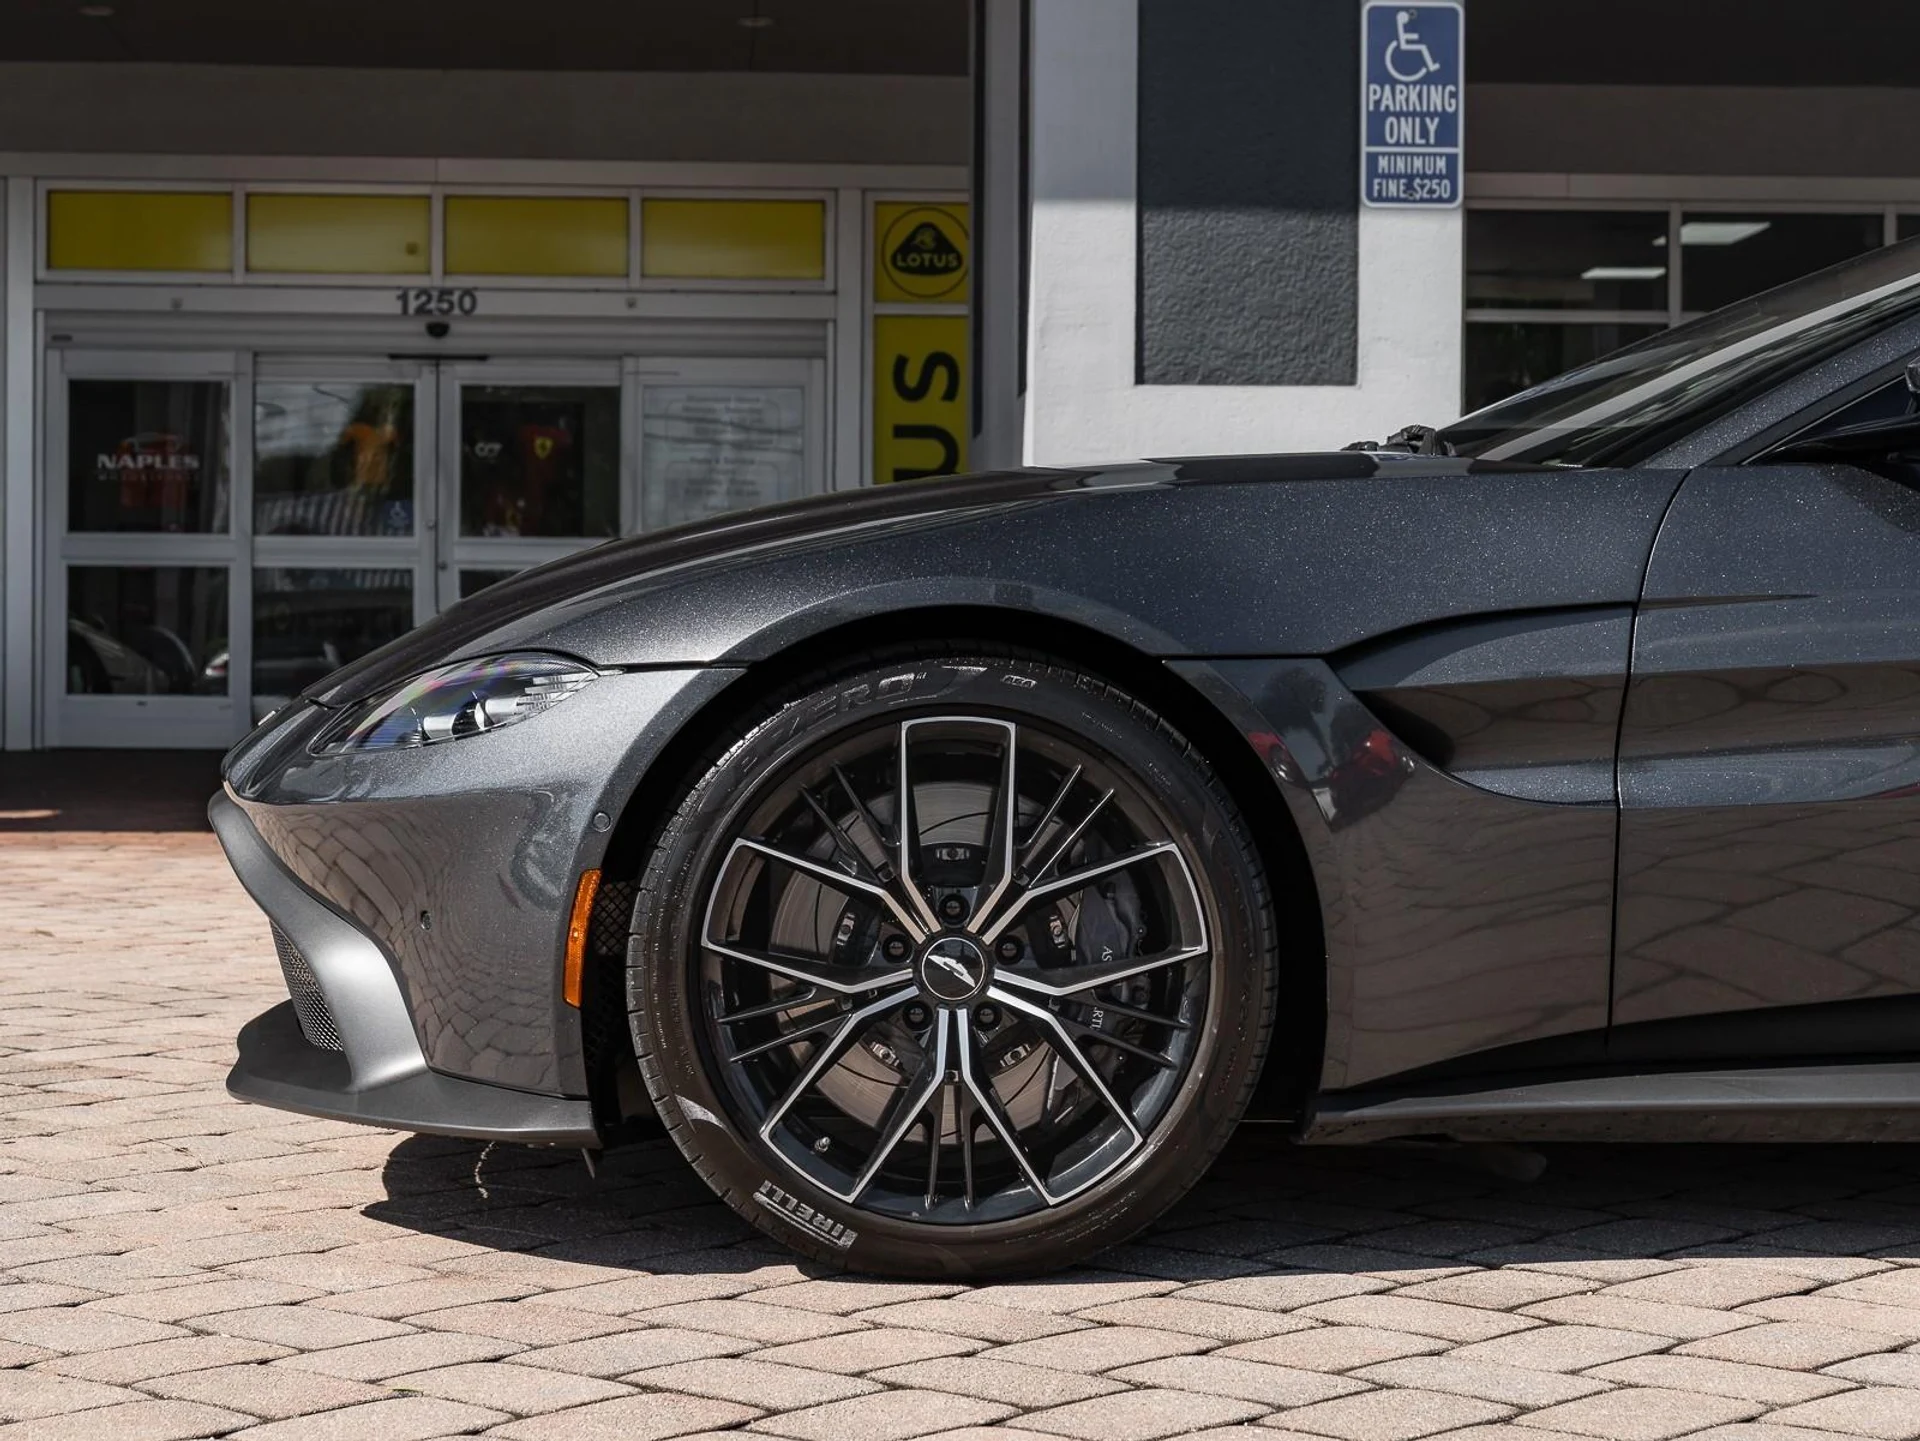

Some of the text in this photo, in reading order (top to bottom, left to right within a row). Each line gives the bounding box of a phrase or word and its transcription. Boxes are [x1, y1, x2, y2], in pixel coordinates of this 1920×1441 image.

[1368, 83, 1457, 113] PARKING
[1384, 116, 1440, 145] ONLY
[1377, 155, 1447, 175] MINIMUM
[1373, 177, 1451, 200] FINE $250
[896, 252, 959, 268] LOTUS
[395, 287, 478, 316] 1250
[97, 453, 200, 470] NAPLES
[752, 1179, 858, 1250] PIRELLI
